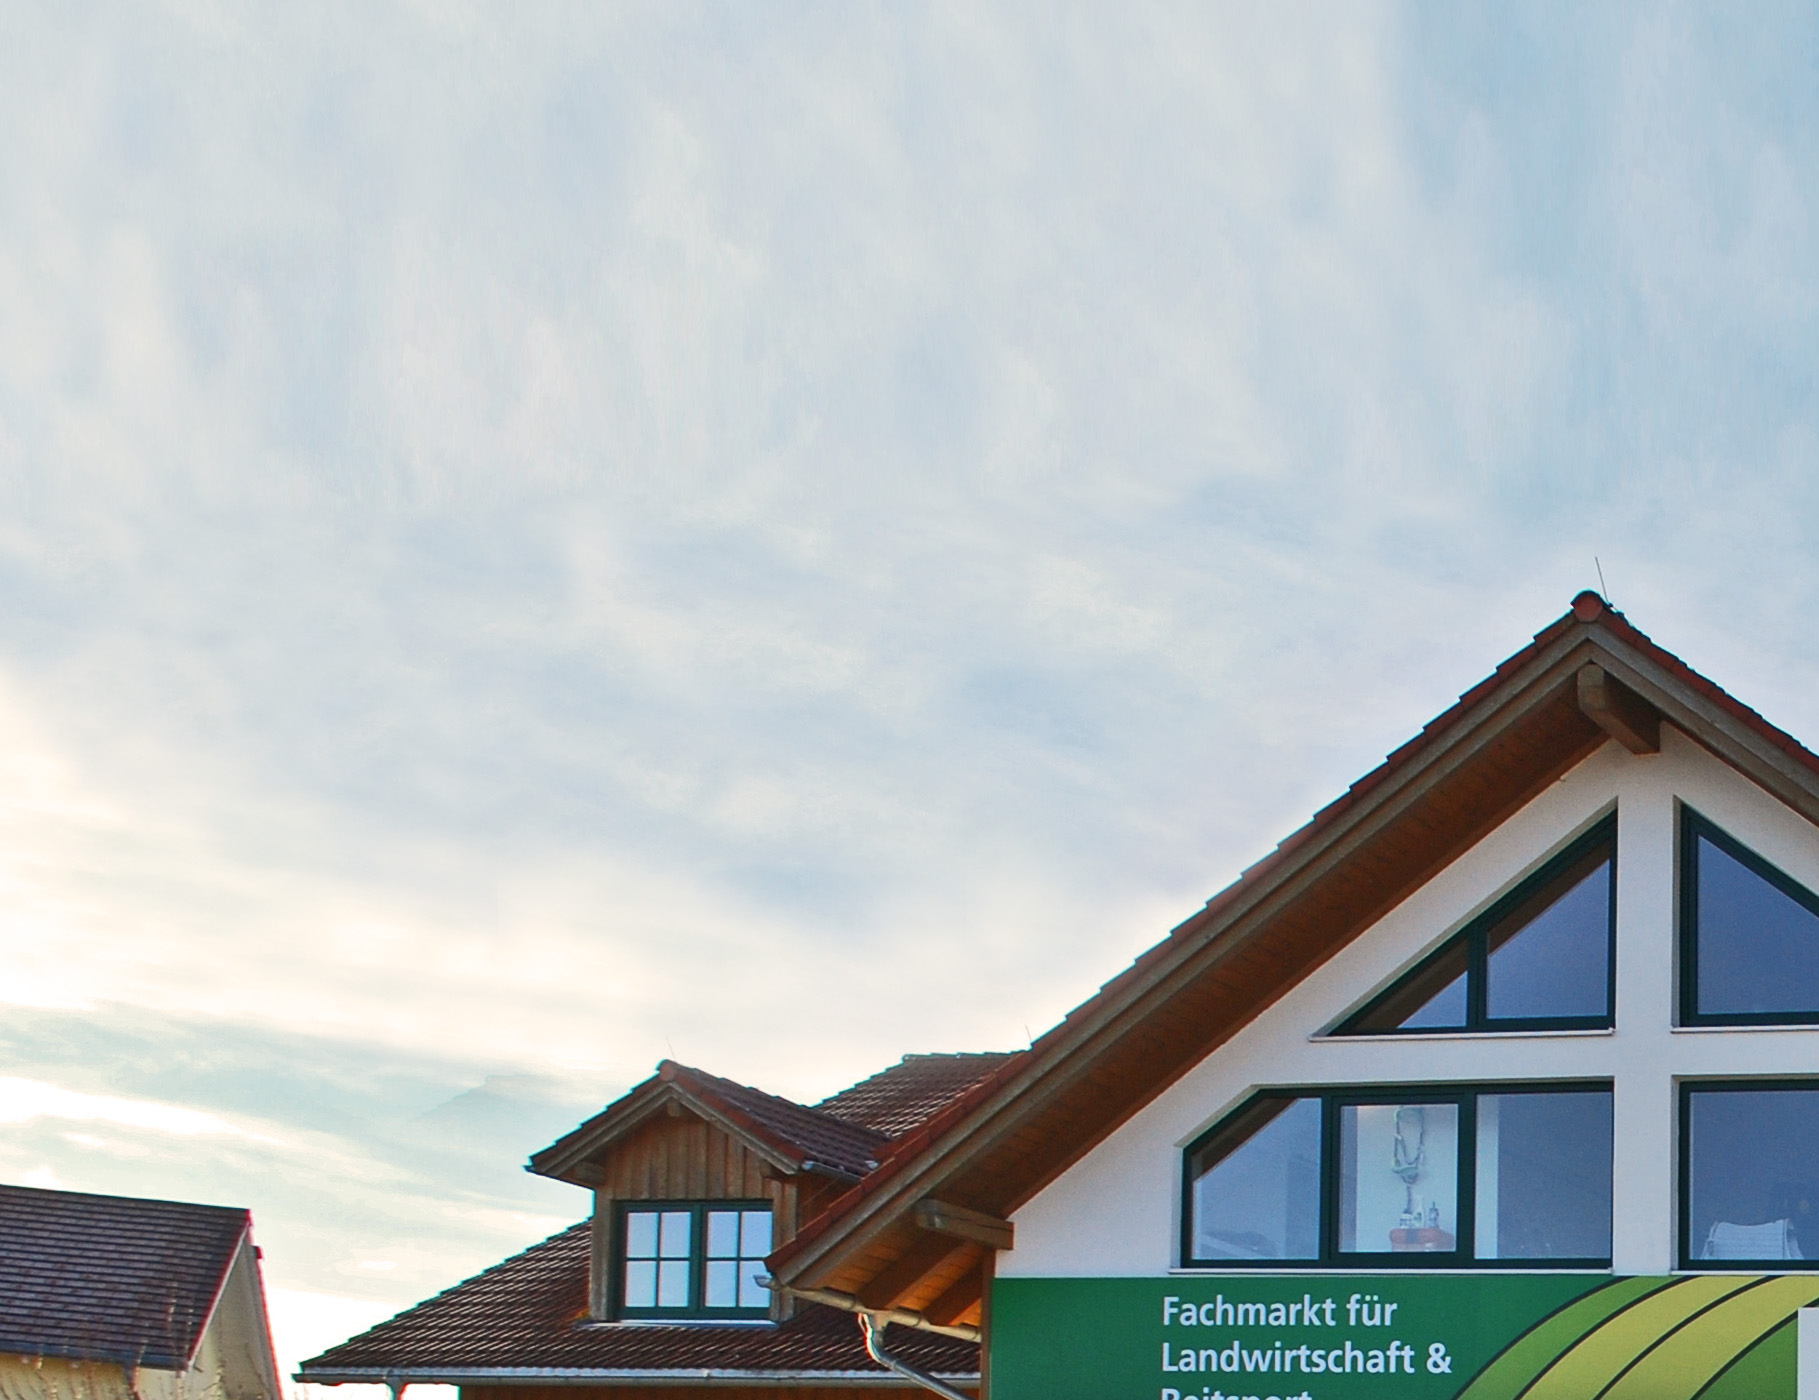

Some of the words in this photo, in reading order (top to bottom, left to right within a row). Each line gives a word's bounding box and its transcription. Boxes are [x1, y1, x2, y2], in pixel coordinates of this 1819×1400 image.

[1162, 1294, 1337, 1327] Fachmarkt
[1346, 1293, 1398, 1326] für
[1161, 1340, 1416, 1374] Landwirtschaft
[1426, 1342, 1453, 1374] &
